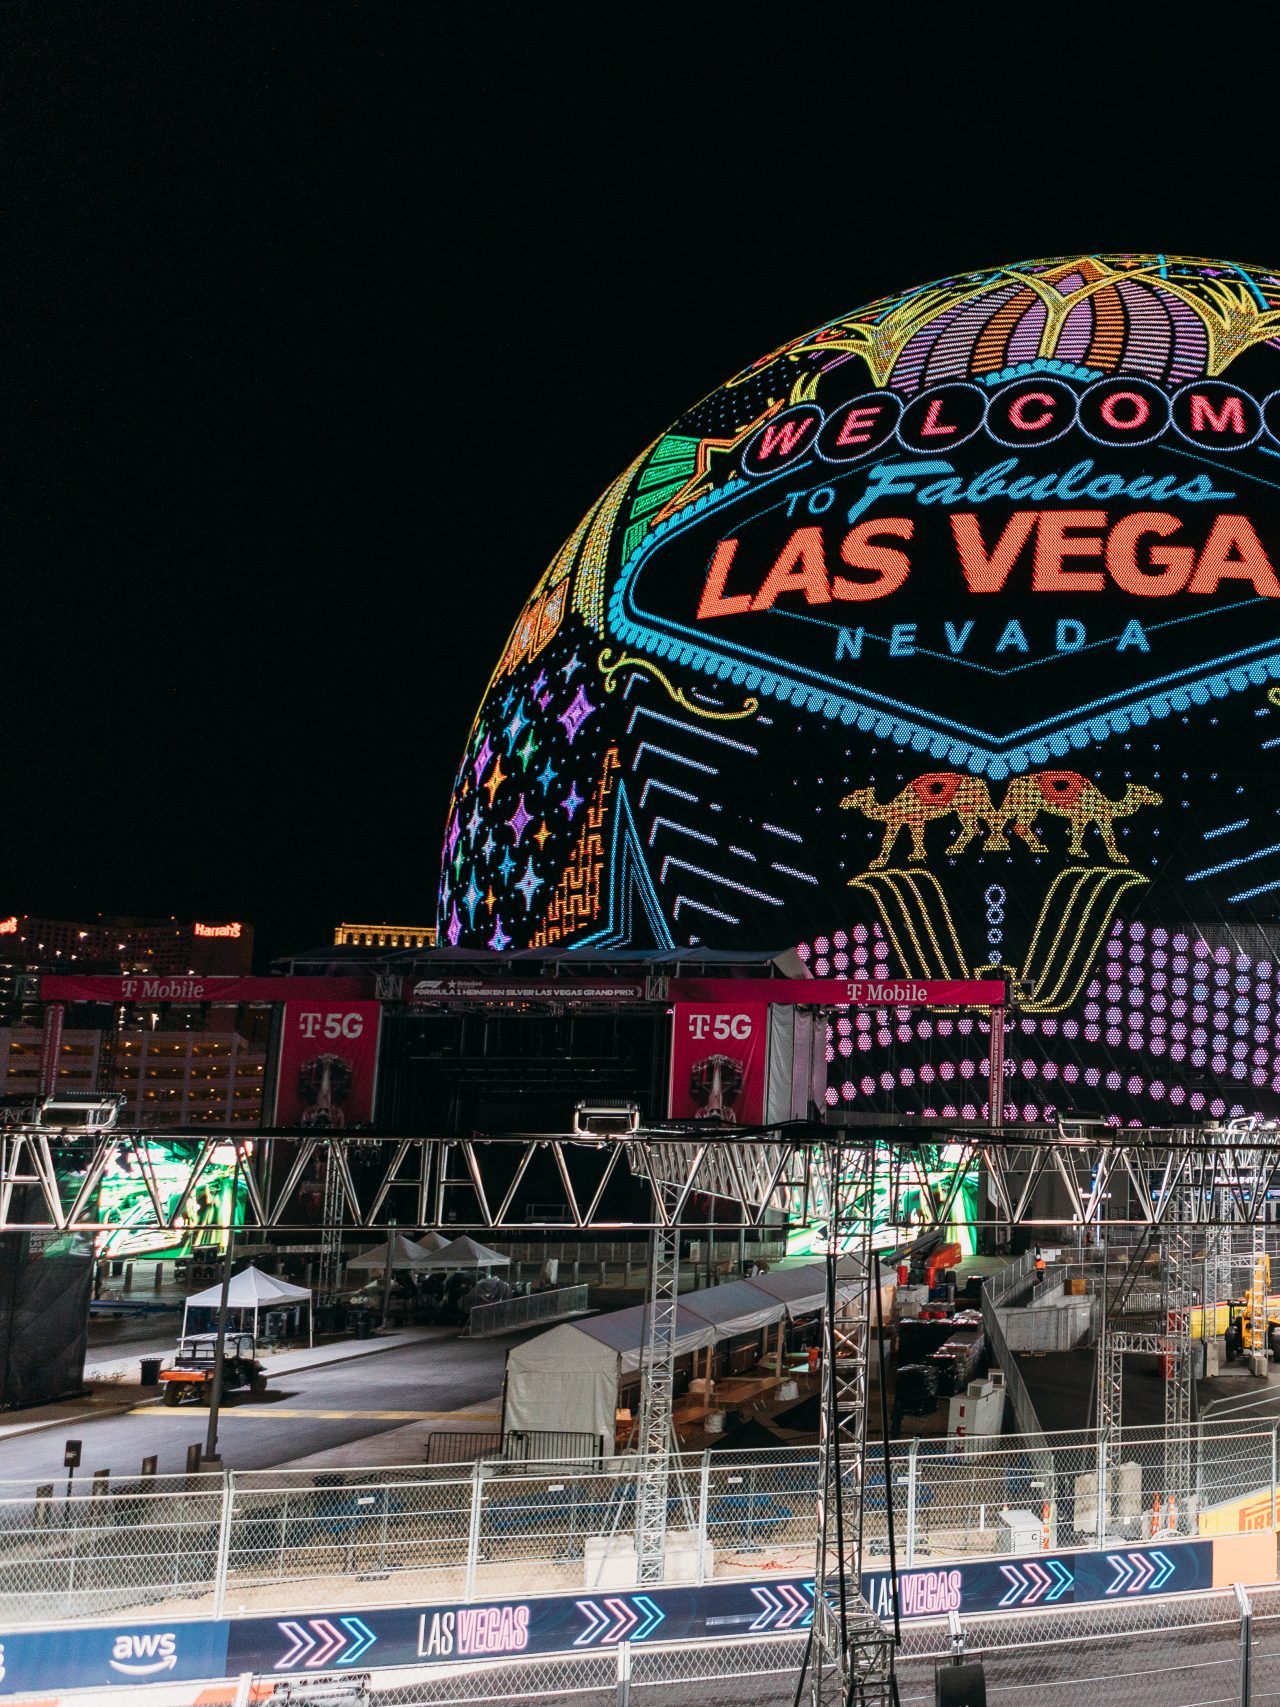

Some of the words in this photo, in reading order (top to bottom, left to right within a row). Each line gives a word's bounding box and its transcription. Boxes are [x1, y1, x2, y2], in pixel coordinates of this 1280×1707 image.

[785, 487, 836, 518] TO
[847, 457, 1237, 525] Fabulous
[695, 516, 915, 619] LAS
[834, 618, 1151, 661] NEVADA
[121, 980, 138, 998] T
[140, 980, 205, 999] Mobile
[847, 983, 863, 1001] T
[866, 984, 928, 1002] Mobile
[299, 1013, 322, 1038] T
[323, 1012, 364, 1039] 5G
[688, 1014, 711, 1040] T
[712, 1013, 752, 1040] 5G
[901, 1570, 962, 1615] VEGAS
[112, 1632, 177, 1660] aws
[417, 1611, 456, 1658] LAS
[456, 1605, 530, 1655] VEGAS
